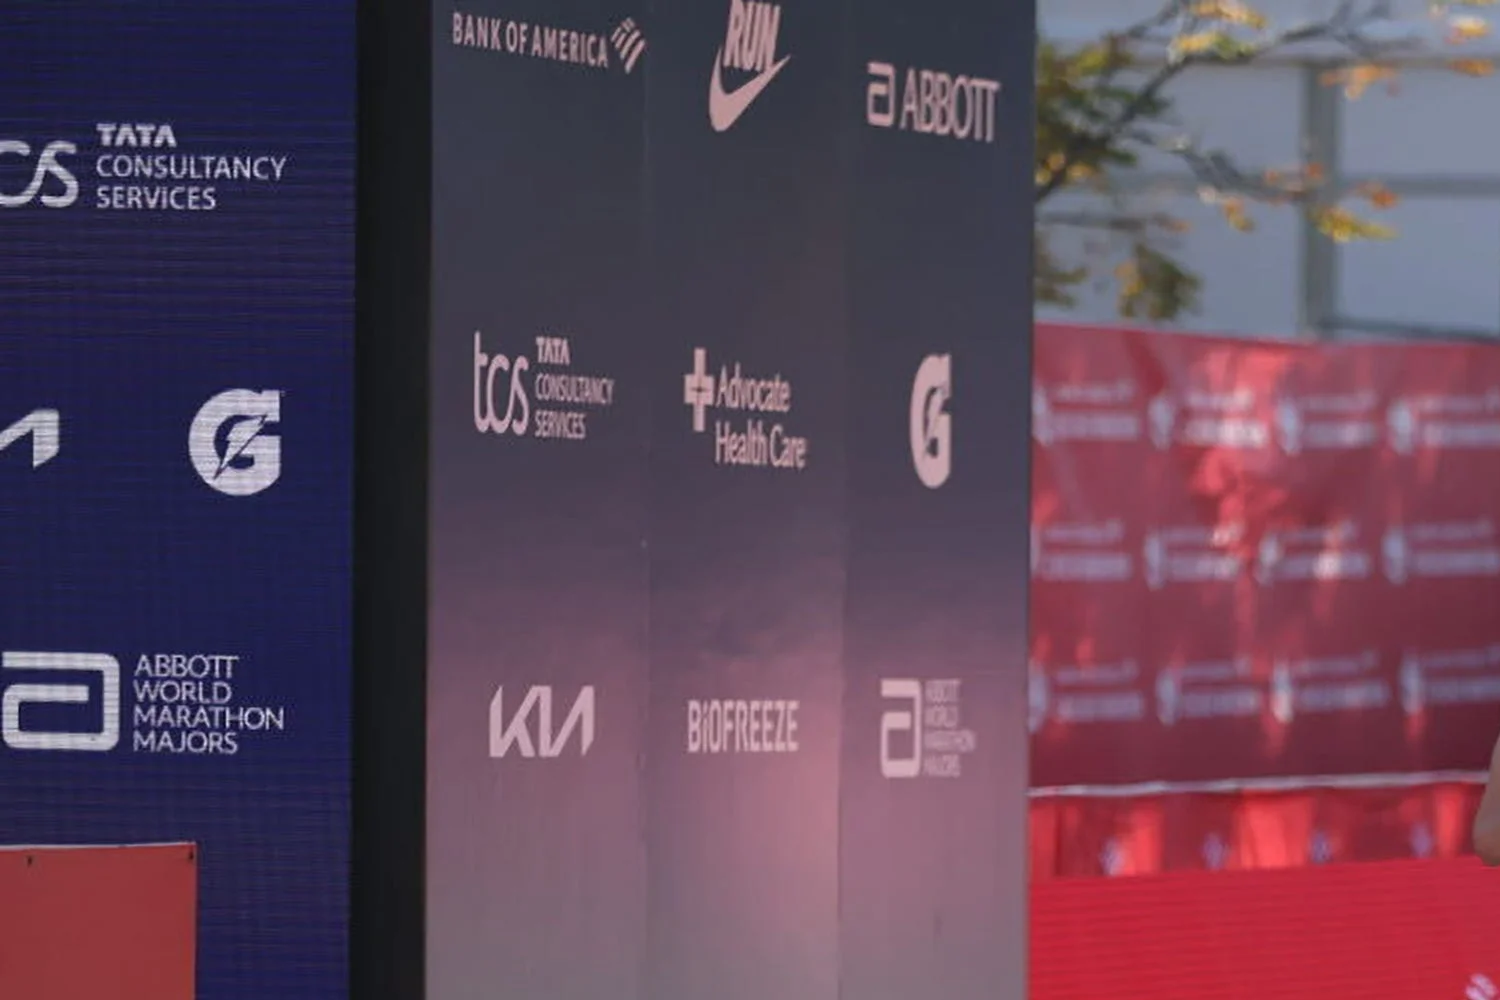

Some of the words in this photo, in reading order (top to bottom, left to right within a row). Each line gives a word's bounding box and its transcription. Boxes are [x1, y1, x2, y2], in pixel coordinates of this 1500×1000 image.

[453, 12, 501, 50] BANK
[506, 21, 528, 55] OF
[531, 25, 608, 68] AMERICA
[723, 0, 781, 72] RUN
[900, 67, 1000, 143] ABBOTT
[96, 123, 177, 147] TATA
[96, 154, 286, 181] CONSULTANCY
[96, 186, 216, 210] SERVICES
[536, 336, 571, 365] TATA
[535, 373, 615, 405] CONSULTANCY
[716, 362, 792, 413] Advocate
[535, 410, 587, 439] SERVICES
[715, 419, 767, 464] Health
[770, 425, 807, 468] Care
[134, 655, 239, 678] ABBOTT
[133, 680, 232, 704] WORLD
[133, 705, 284, 730] MARATHON
[133, 731, 238, 754] MAJORS
